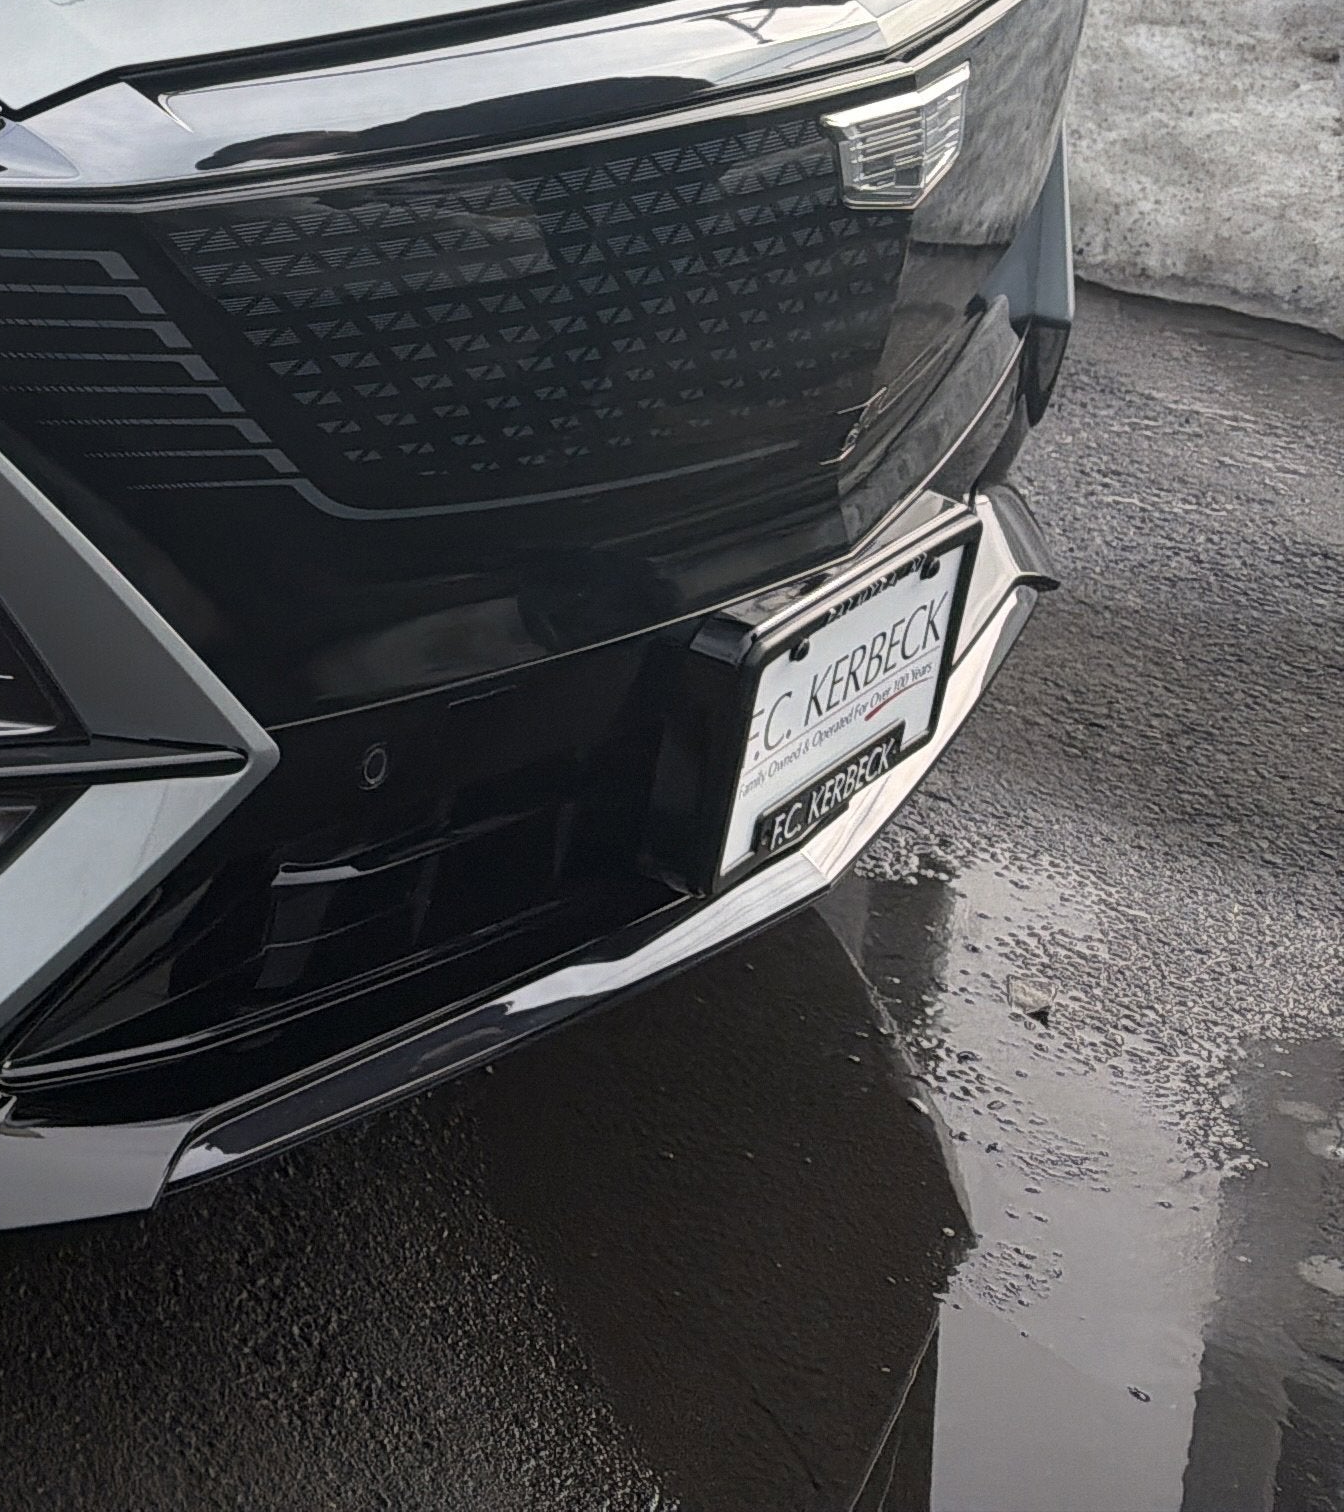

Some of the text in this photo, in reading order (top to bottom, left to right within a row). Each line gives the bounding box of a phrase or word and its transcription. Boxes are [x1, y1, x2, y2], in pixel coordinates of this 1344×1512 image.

[803, 590, 949, 728] KERBECK
[768, 745, 802, 778] Owned
[801, 741, 810, 755] &
[811, 706, 854, 748] Operated
[870, 687, 891, 707] Over
[894, 673, 910, 691] 100
[911, 662, 933, 681] Years
[769, 737, 896, 851] F.C. KERBECK
